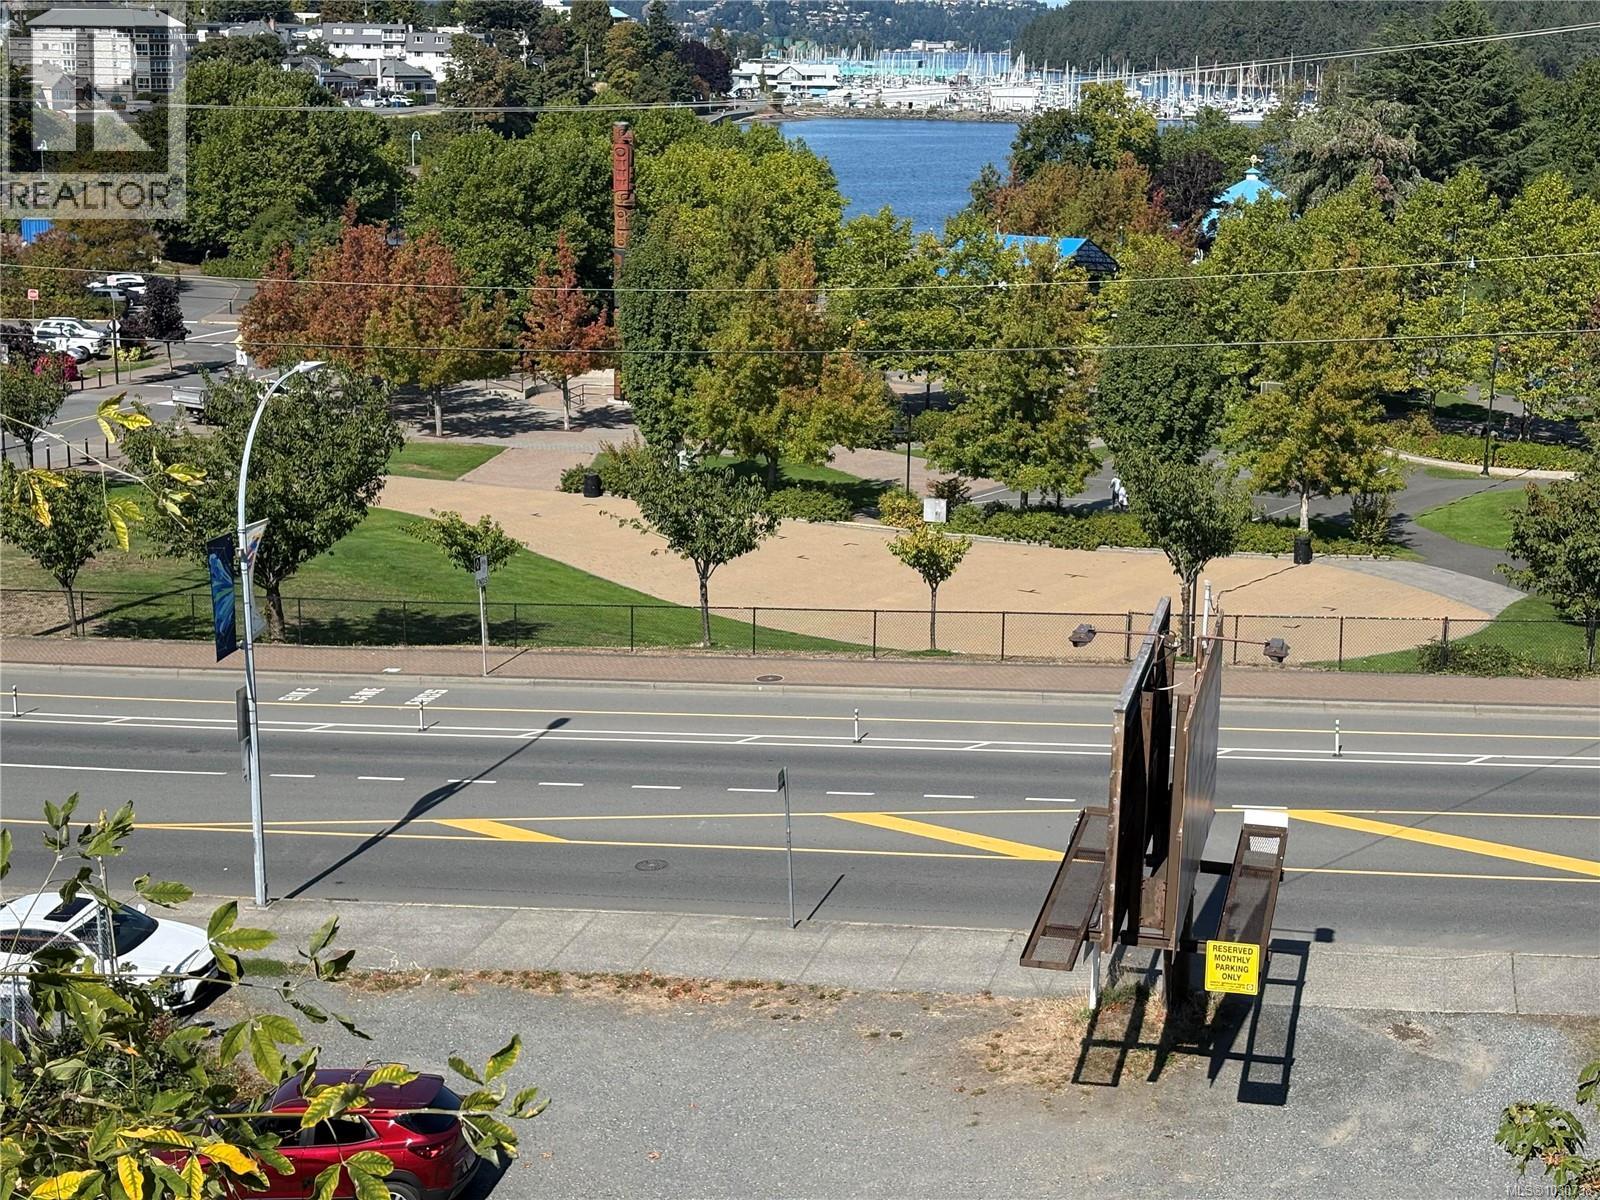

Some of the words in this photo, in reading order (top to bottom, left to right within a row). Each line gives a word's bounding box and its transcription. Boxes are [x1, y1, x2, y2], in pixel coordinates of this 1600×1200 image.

[1212, 944, 1253, 955] RESERVED
[1214, 954, 1251, 964] MONTHLY
[1215, 963, 1249, 973] PARKING
[1221, 972, 1241, 981] ONLY
